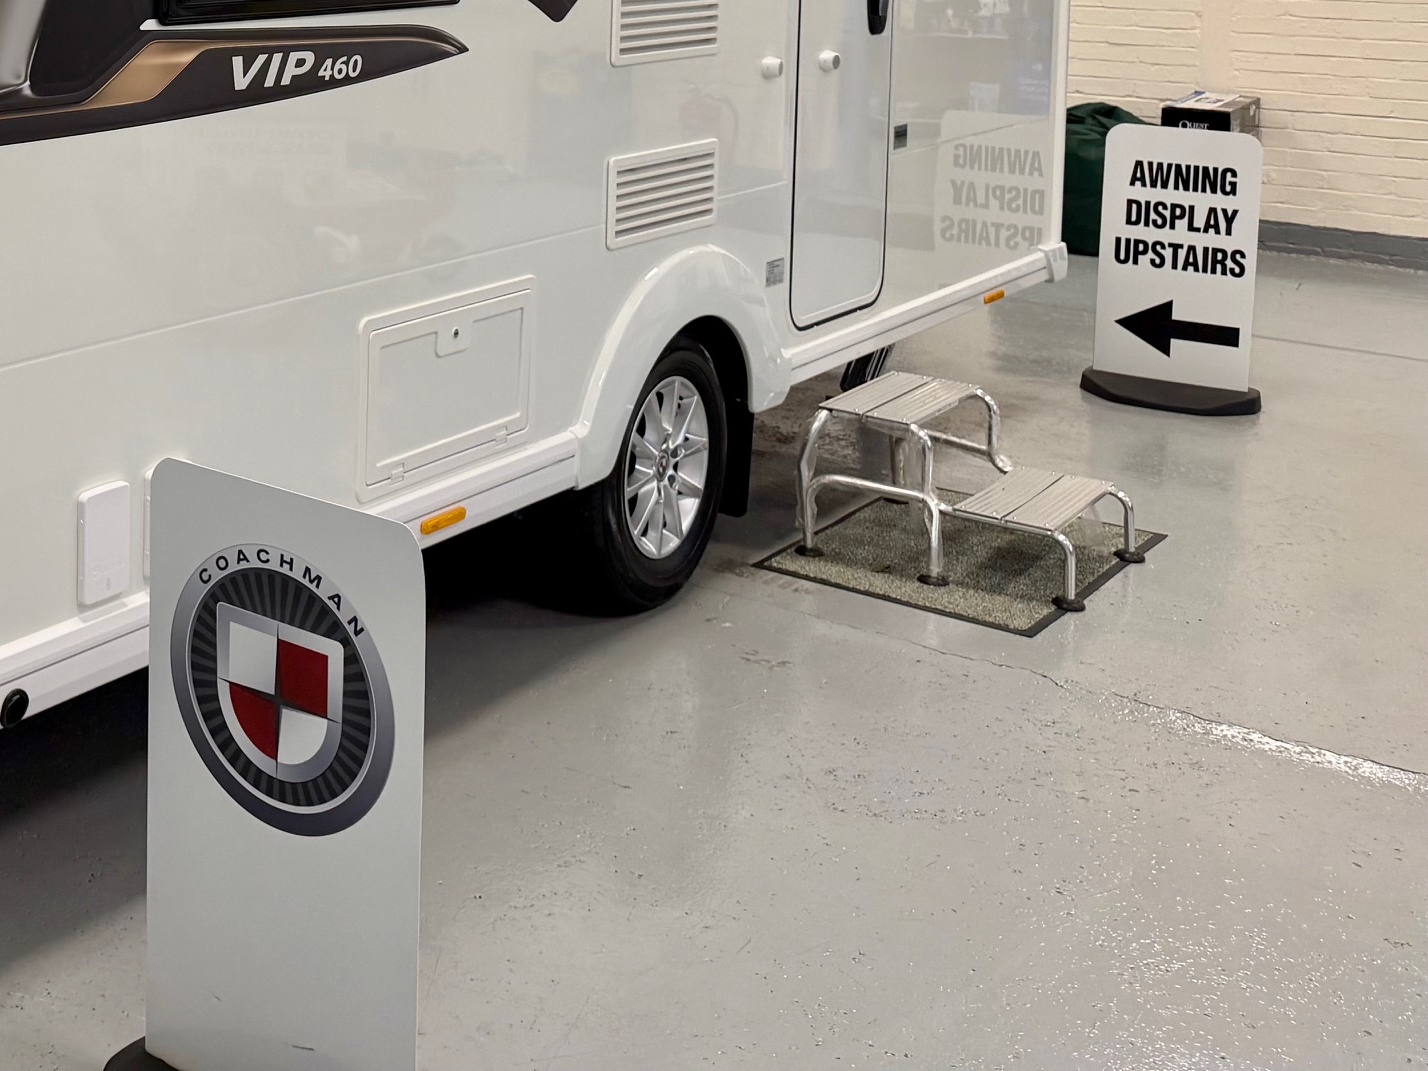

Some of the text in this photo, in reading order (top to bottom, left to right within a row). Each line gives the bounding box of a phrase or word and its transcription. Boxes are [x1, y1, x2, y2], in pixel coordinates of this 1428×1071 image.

[231, 51, 363, 91] VIP 460
[1129, 159, 1238, 197] AWNING
[1125, 198, 1239, 237] DISPLAY
[1114, 236, 1246, 279] UPSTAIRS
[199, 547, 365, 638] COACHMAN
